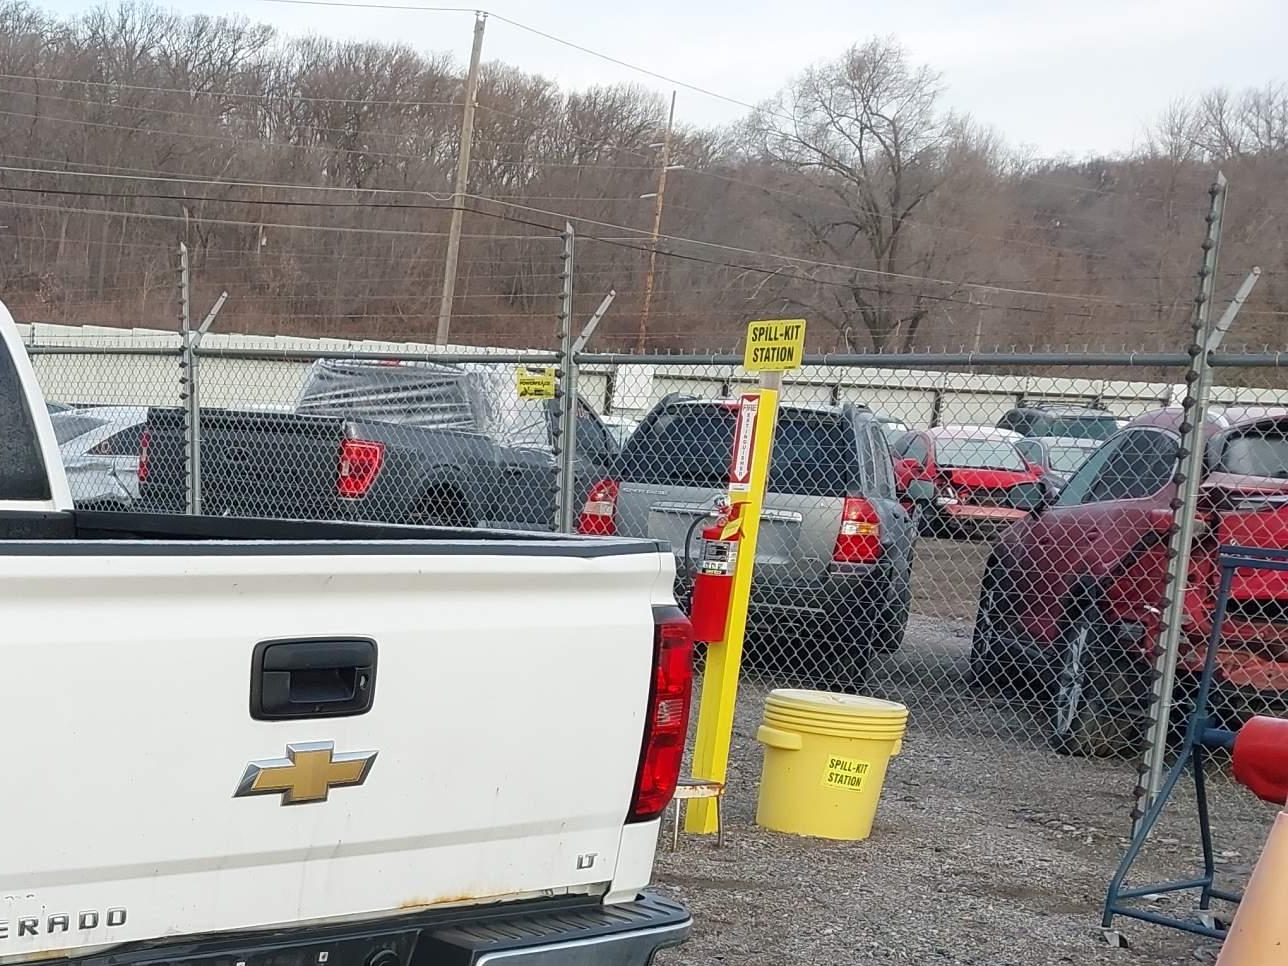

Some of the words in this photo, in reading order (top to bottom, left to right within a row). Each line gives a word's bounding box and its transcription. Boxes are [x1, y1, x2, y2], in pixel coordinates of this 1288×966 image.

[752, 325, 801, 342] SPILL-KIT
[752, 346, 794, 363] STATION
[829, 758, 869, 774] SPILL-KIT
[827, 772, 862, 787] STATION
[576, 852, 599, 870] LT
